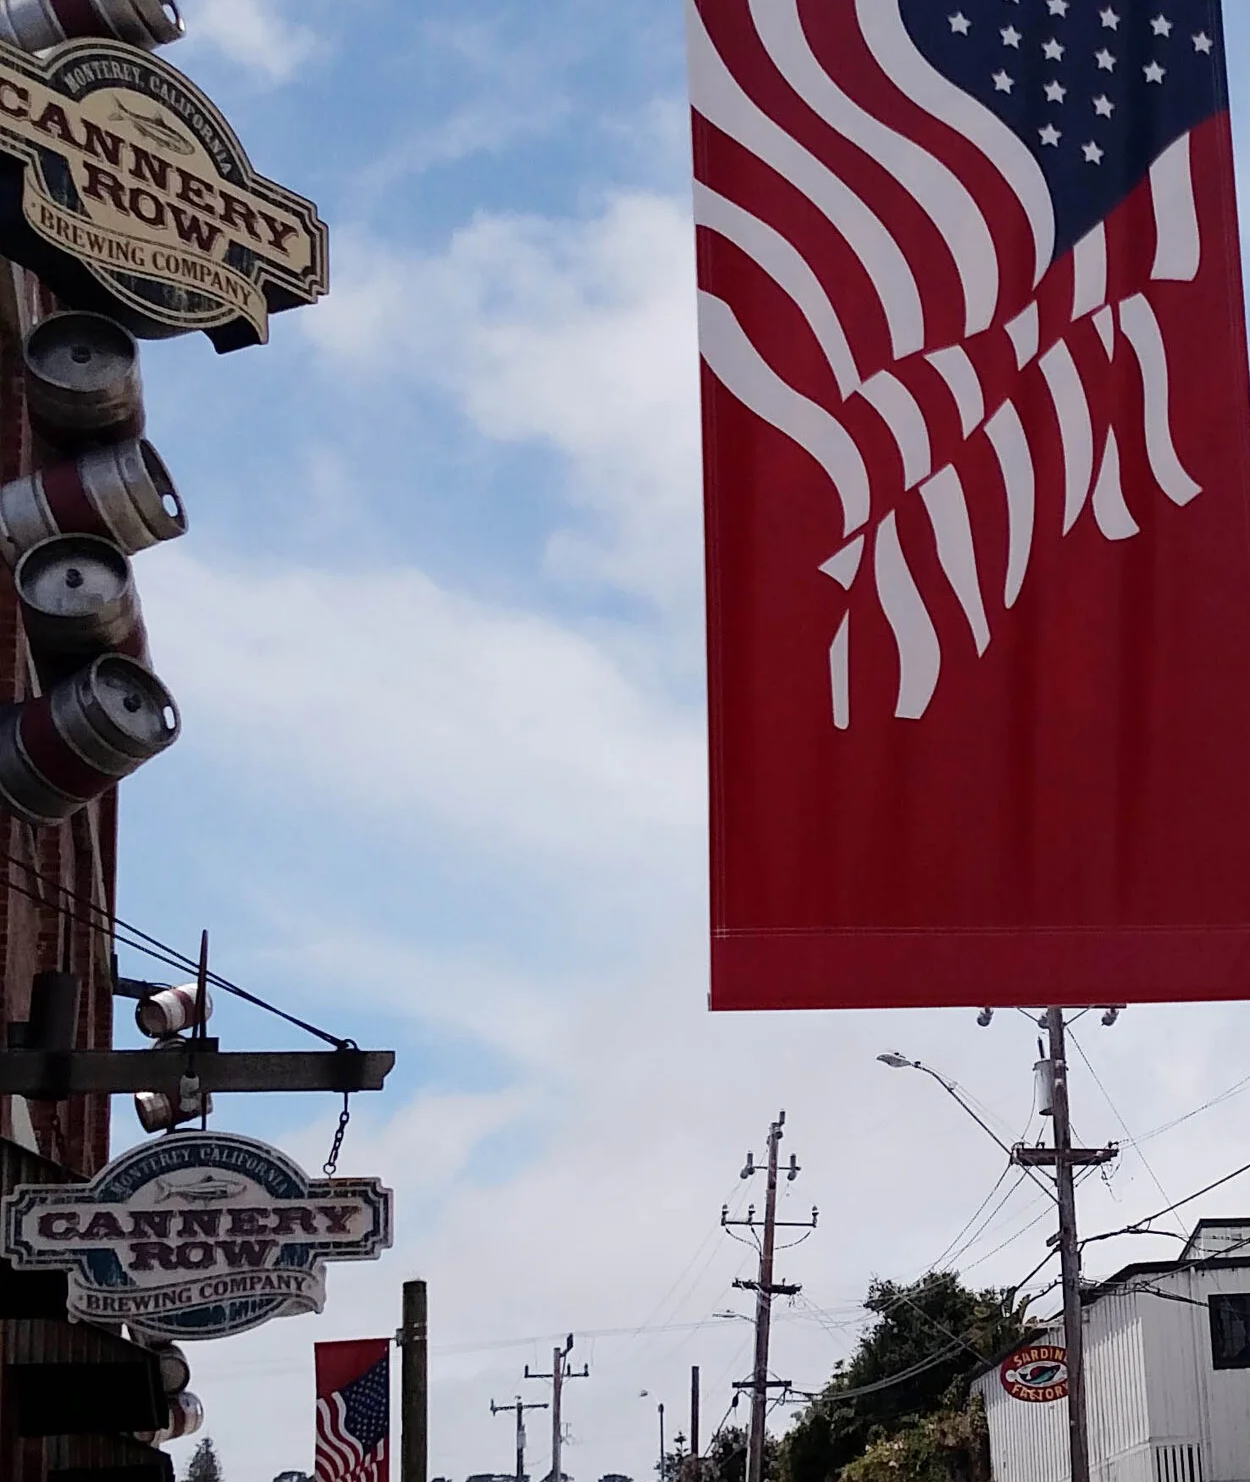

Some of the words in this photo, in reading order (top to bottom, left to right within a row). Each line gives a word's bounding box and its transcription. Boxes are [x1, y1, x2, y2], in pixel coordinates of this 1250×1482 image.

[149, 75, 232, 176] CALIFORNIA
[0, 77, 299, 257] CANNERY
[82, 160, 224, 255] ROW
[39, 204, 146, 267] BREWING
[152, 251, 254, 308] COMPANY
[199, 1147, 289, 1194] CALIFORNIA
[37, 1205, 363, 1240] CANNERY
[128, 1238, 279, 1271] ROW
[86, 1286, 192, 1312] BREWING
[199, 1274, 309, 1300] COMPANY
[1013, 1348, 1068, 1367] SARDIN
